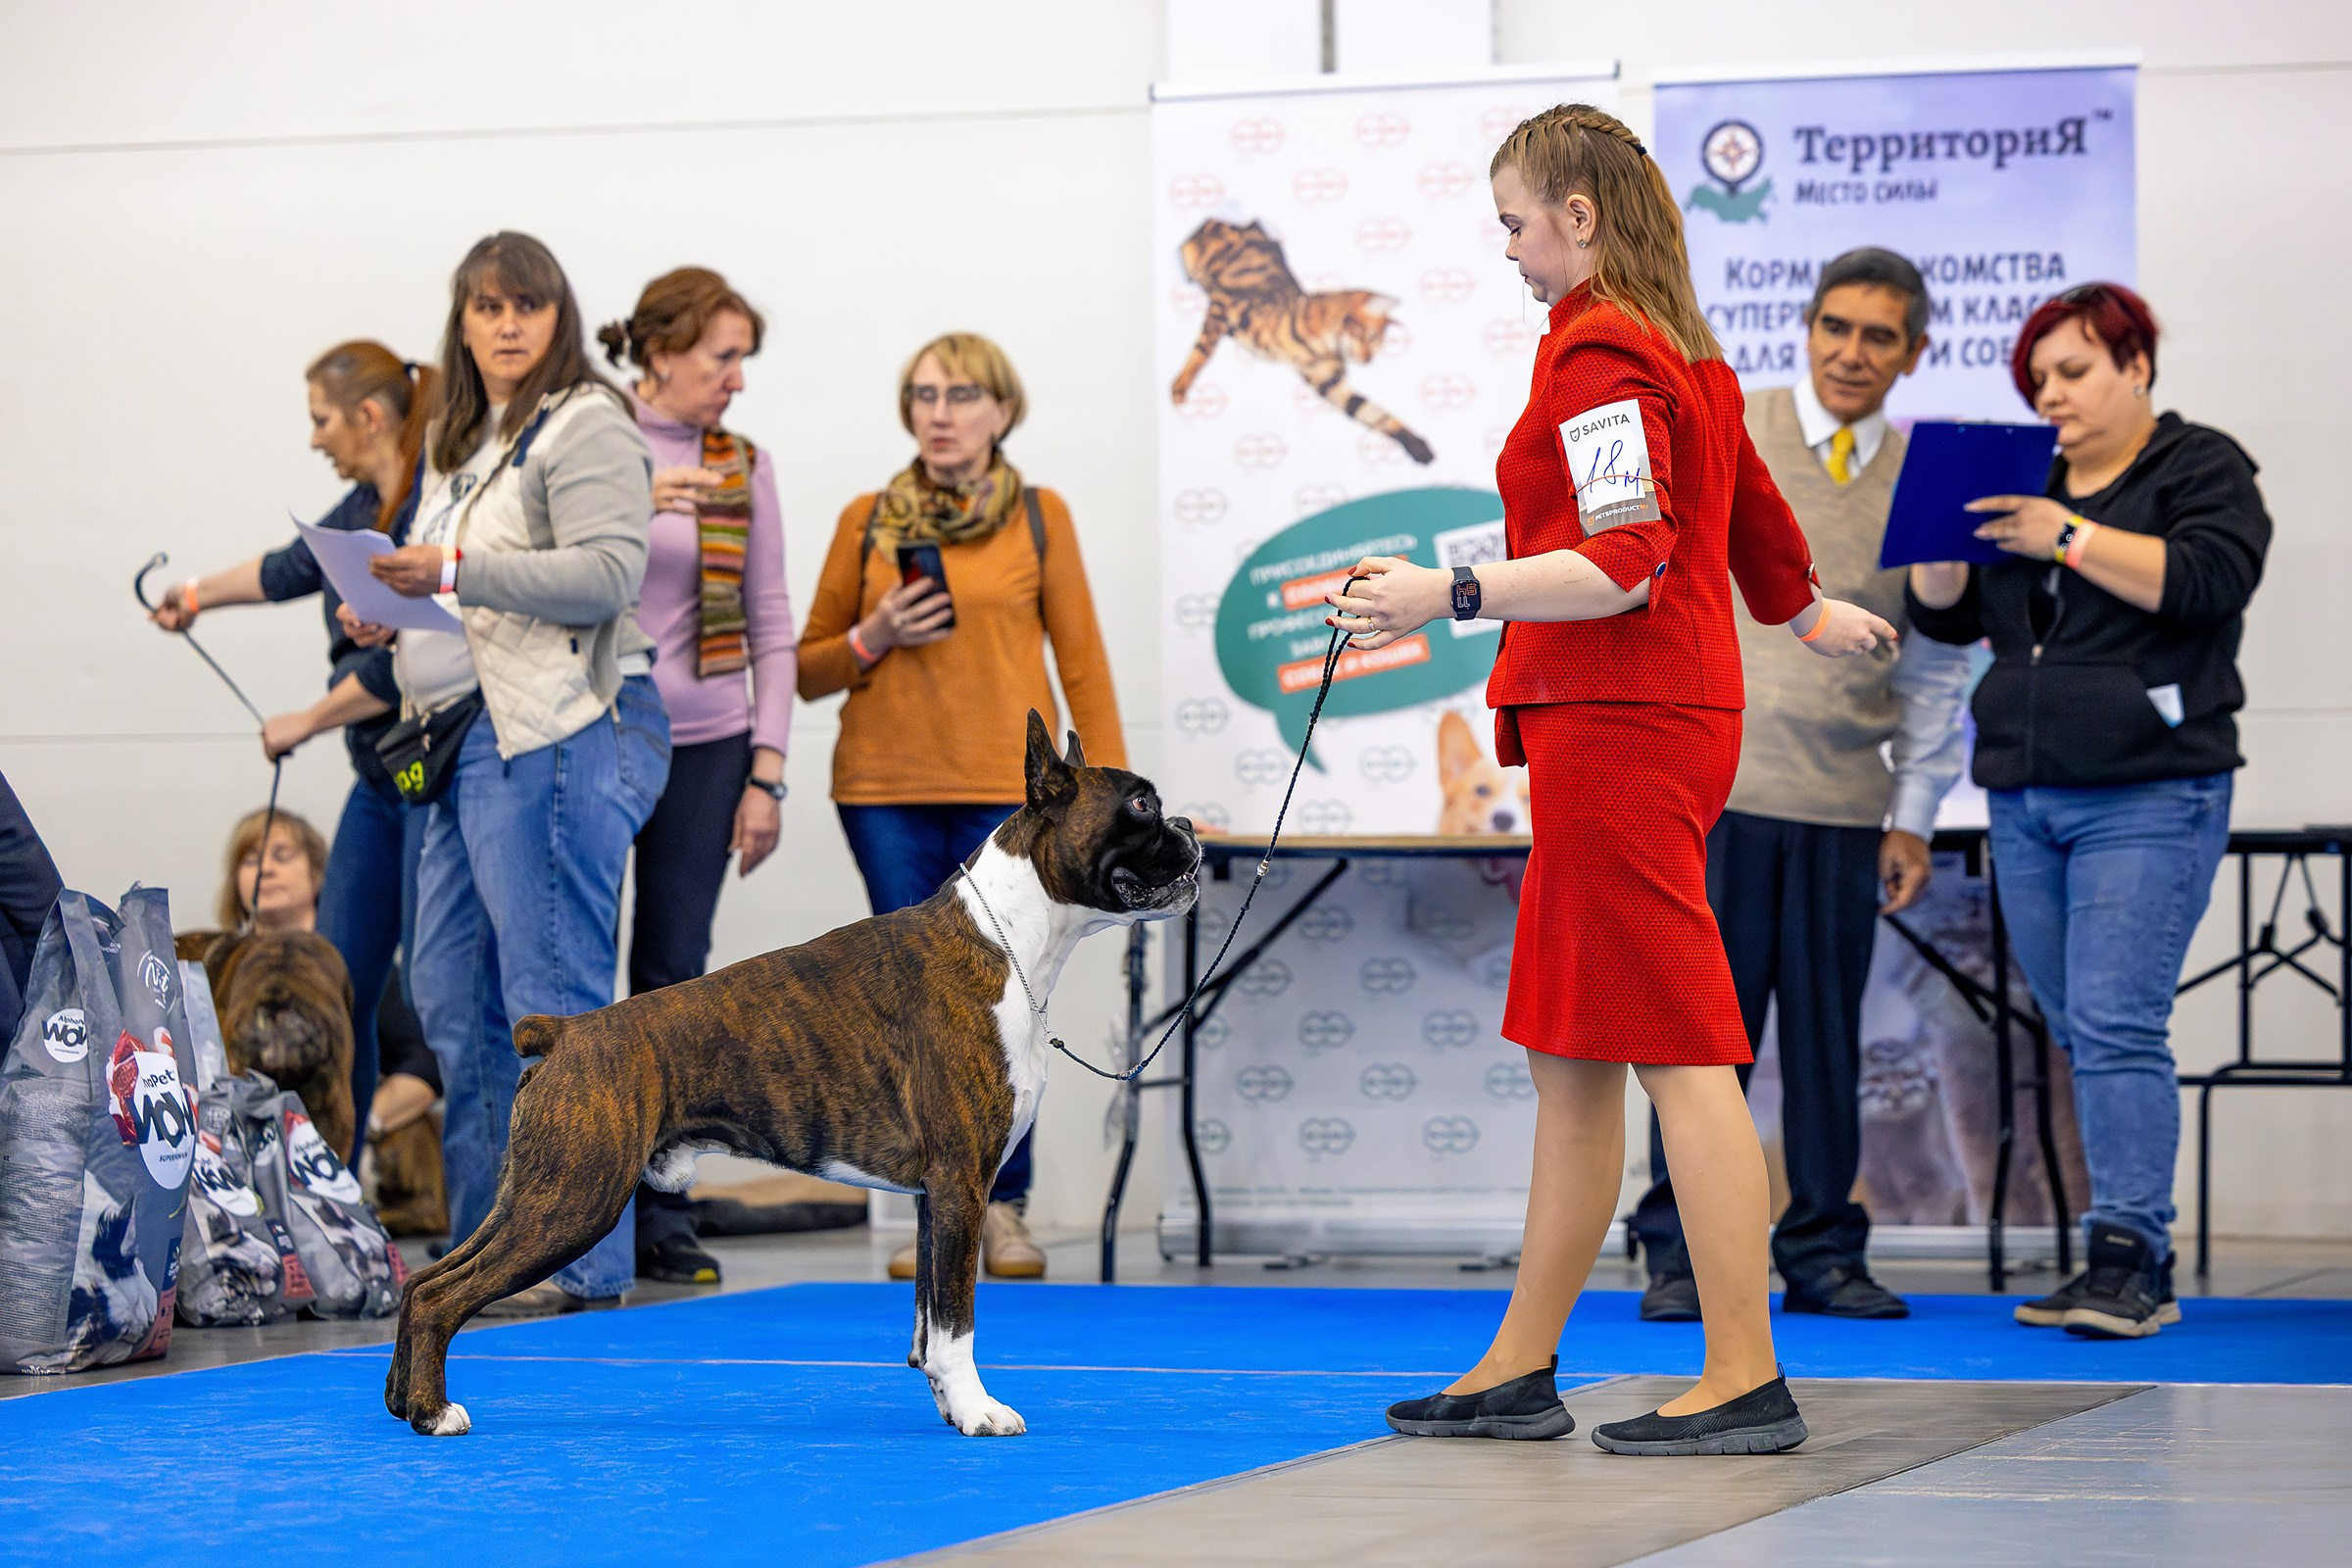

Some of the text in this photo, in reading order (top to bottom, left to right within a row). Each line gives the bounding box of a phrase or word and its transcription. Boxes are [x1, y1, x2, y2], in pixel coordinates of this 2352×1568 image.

[1725, 252, 2066, 290] КОРМ КОМСТВА
[1735, 342, 1795, 372] ДЛЯ
[1582, 414, 1630, 436] SAVITA
